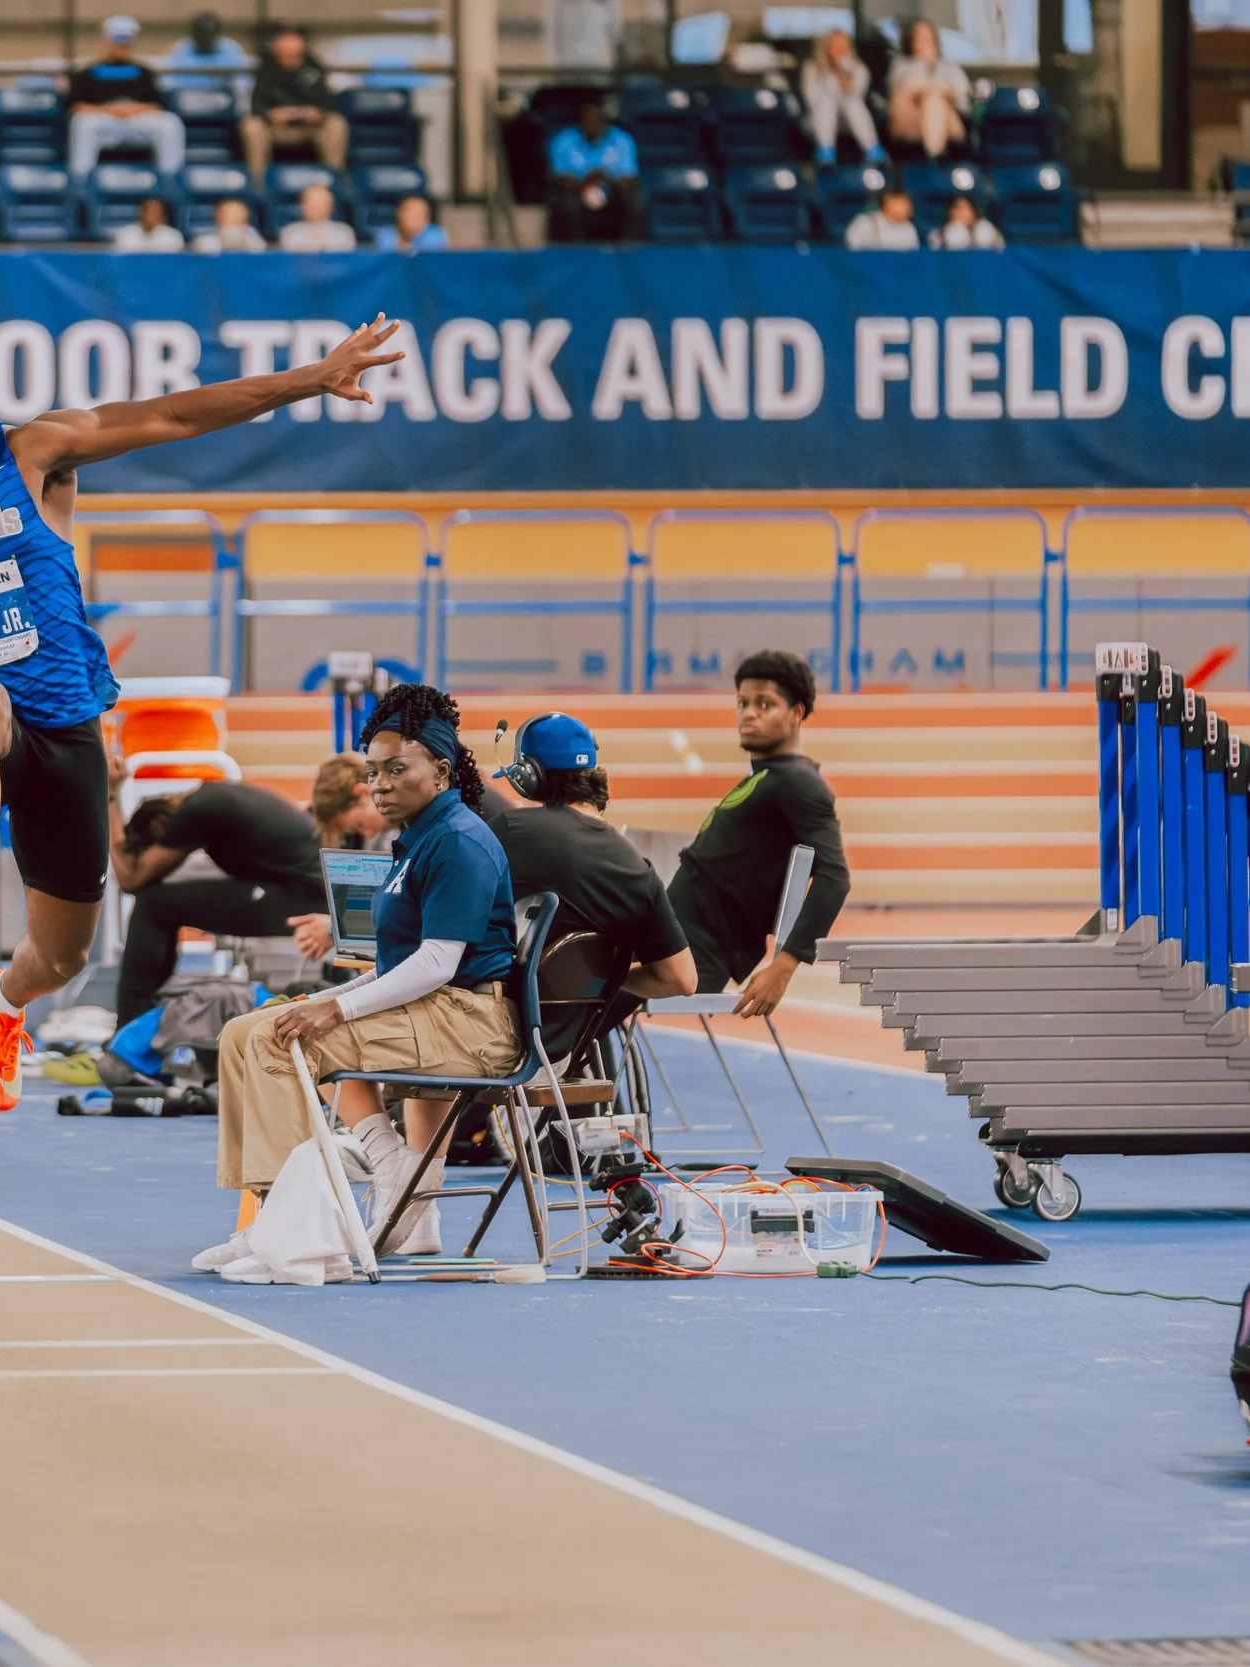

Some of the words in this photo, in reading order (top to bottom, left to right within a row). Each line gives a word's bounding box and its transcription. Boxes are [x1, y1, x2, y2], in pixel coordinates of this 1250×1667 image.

[592, 318, 824, 420] AND
[854, 316, 1129, 420] FIELD
[2, 606, 32, 634] JR.
